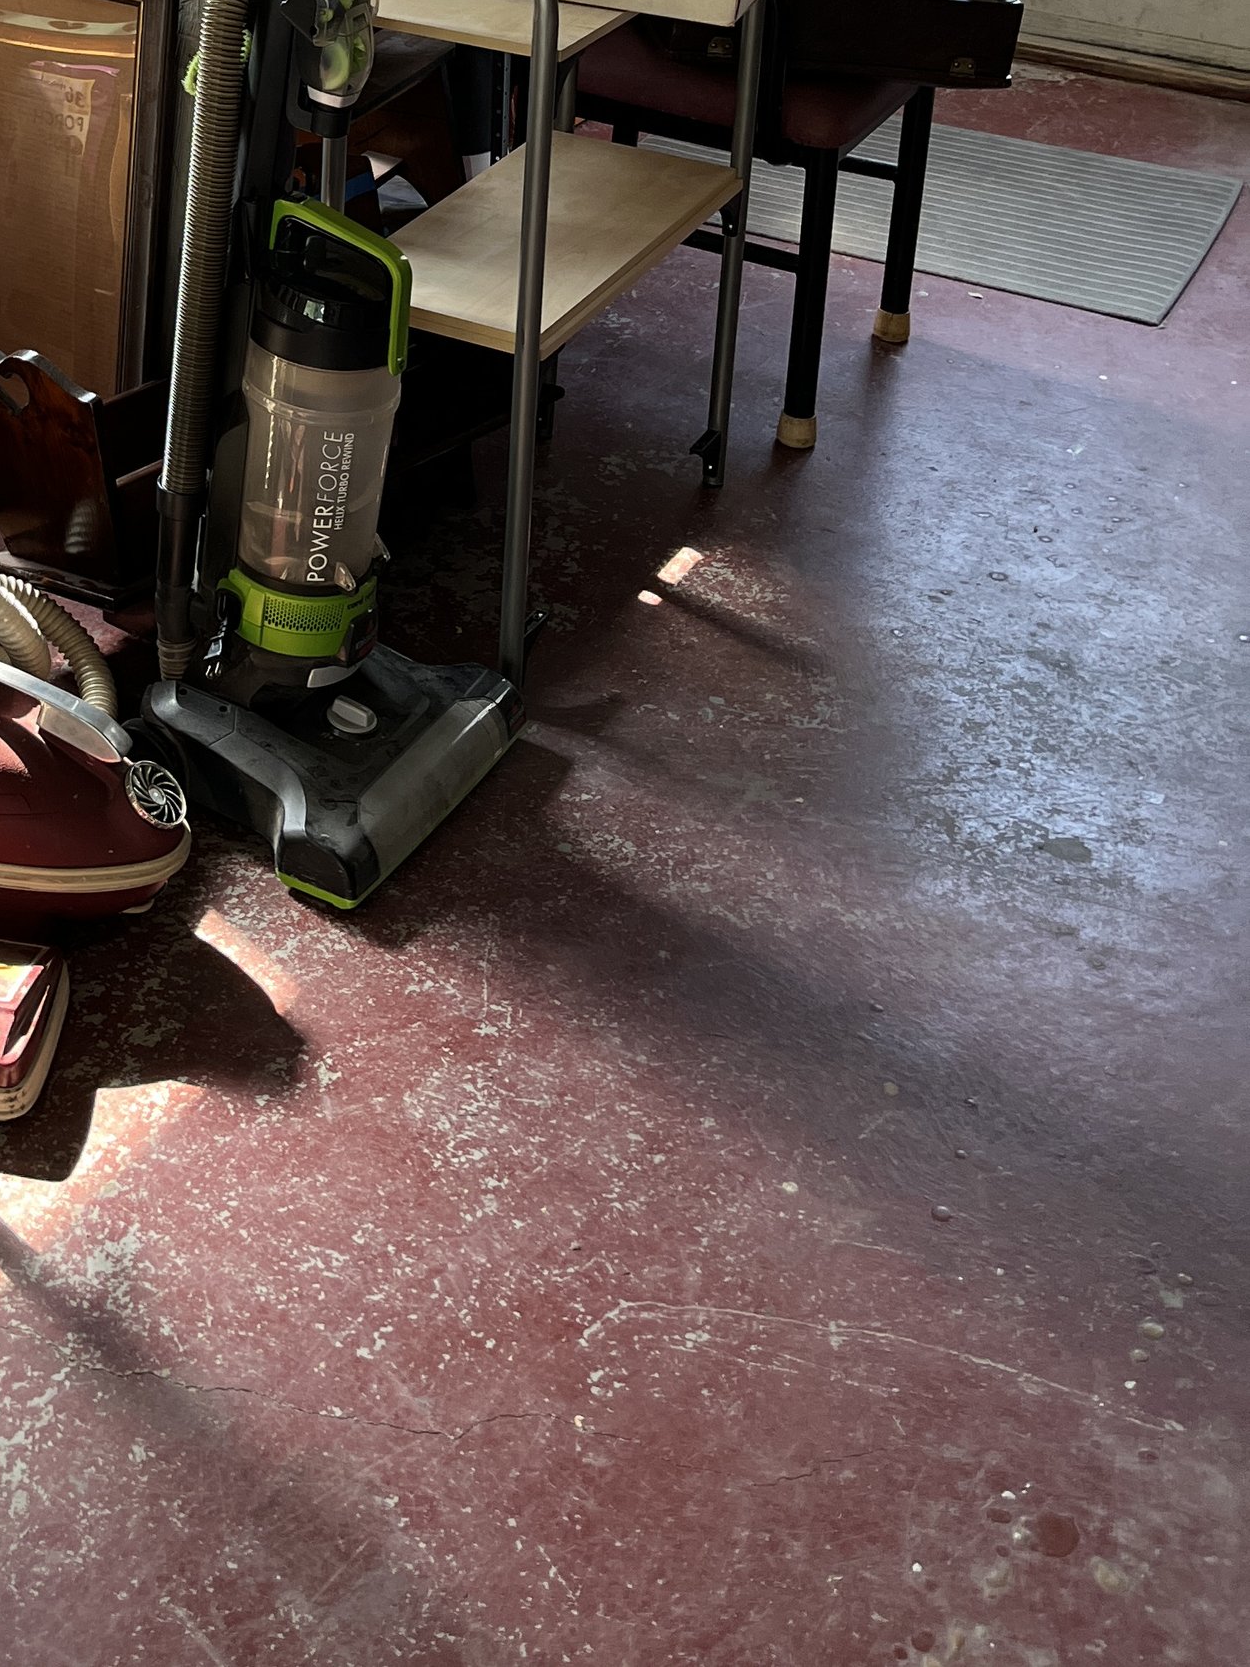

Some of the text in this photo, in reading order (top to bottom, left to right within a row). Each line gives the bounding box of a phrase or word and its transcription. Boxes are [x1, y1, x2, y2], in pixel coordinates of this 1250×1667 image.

[306, 430, 344, 582] POWERFORCE
[333, 432, 355, 530] HELIX TURBO REWIND
